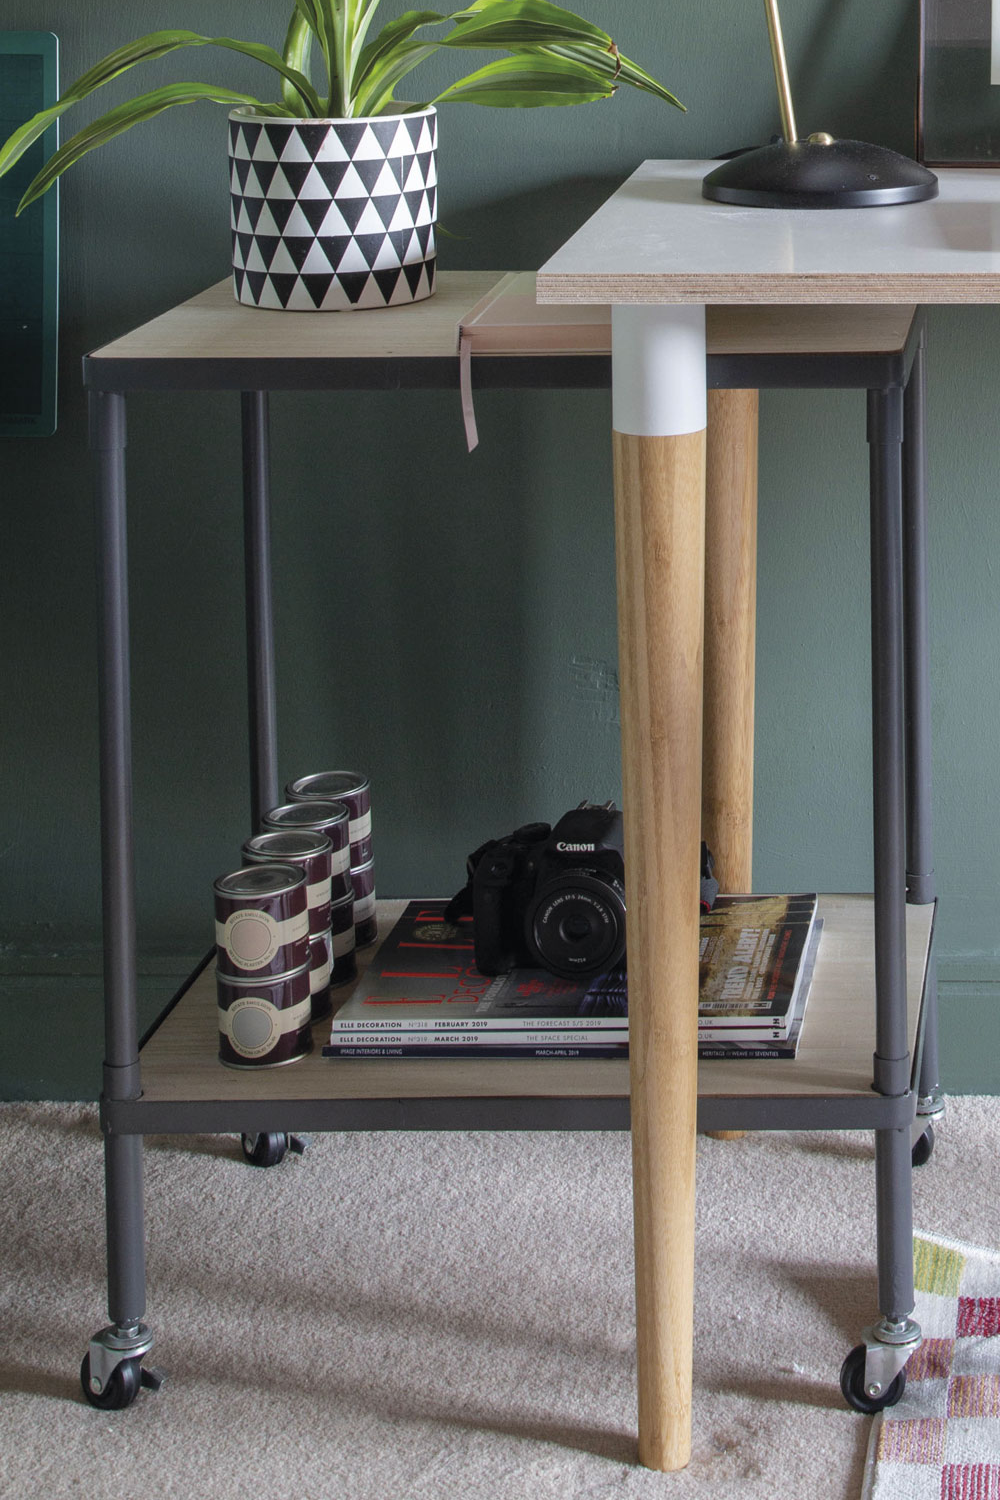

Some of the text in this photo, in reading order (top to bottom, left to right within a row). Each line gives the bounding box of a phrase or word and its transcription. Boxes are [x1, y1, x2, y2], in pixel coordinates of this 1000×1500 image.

[556, 841, 596, 852] Canon
[542, 906, 553, 924] CANON
[552, 897, 564, 907] LENS
[732, 928, 761, 963] ALERT!
[720, 966, 749, 1000] TREND
